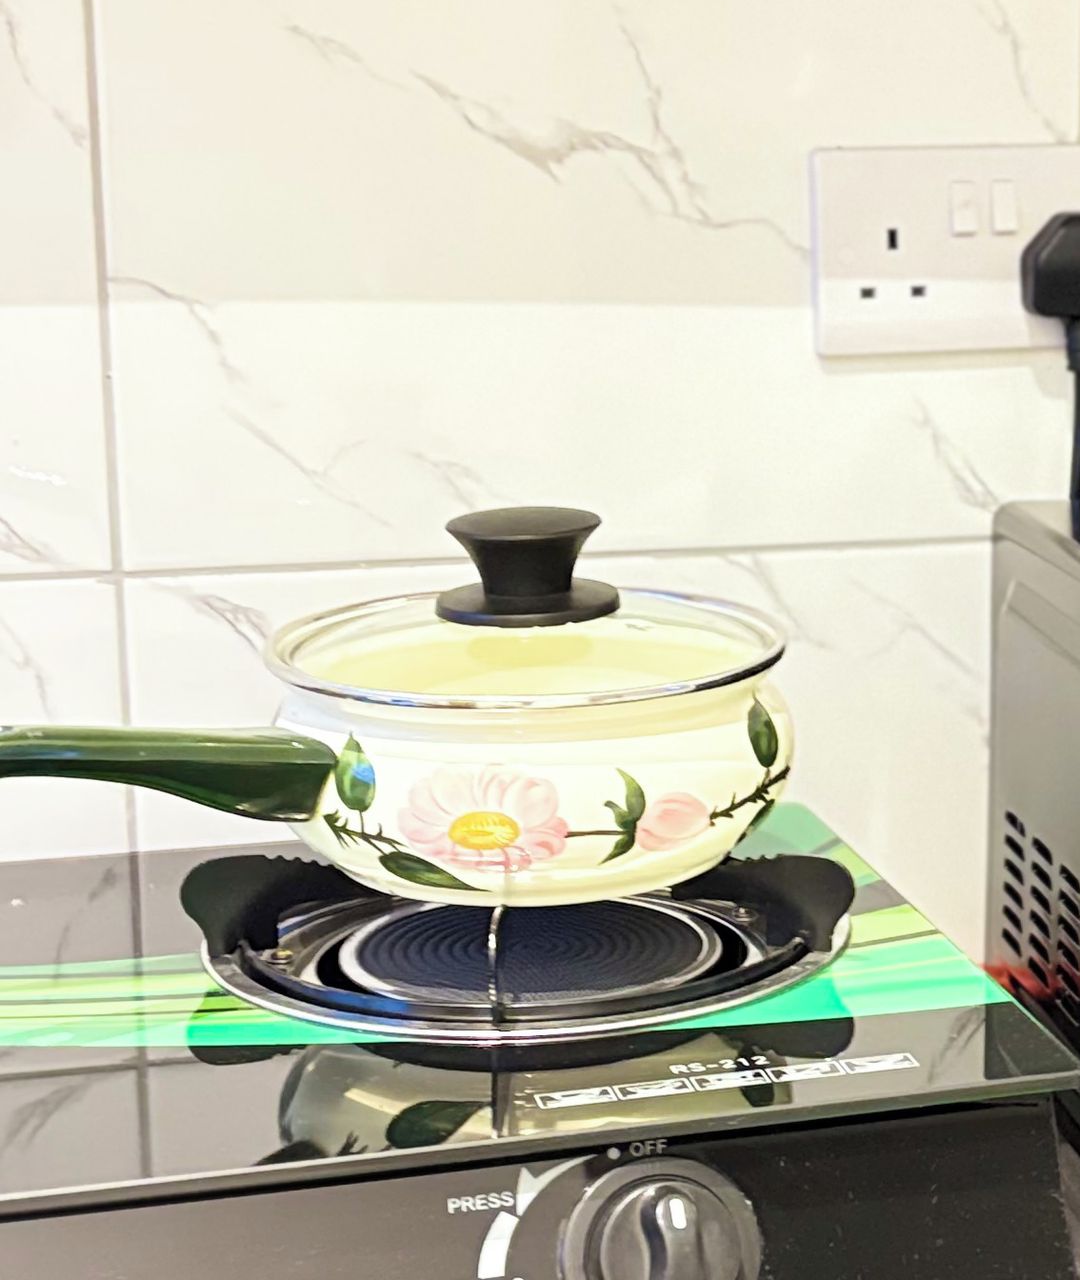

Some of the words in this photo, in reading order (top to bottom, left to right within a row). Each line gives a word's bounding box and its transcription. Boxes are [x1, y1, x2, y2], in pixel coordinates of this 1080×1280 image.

[670, 1055, 771, 1075] RS-212
[629, 1139, 668, 1157] OFF
[447, 1191, 515, 1214] PRESS
